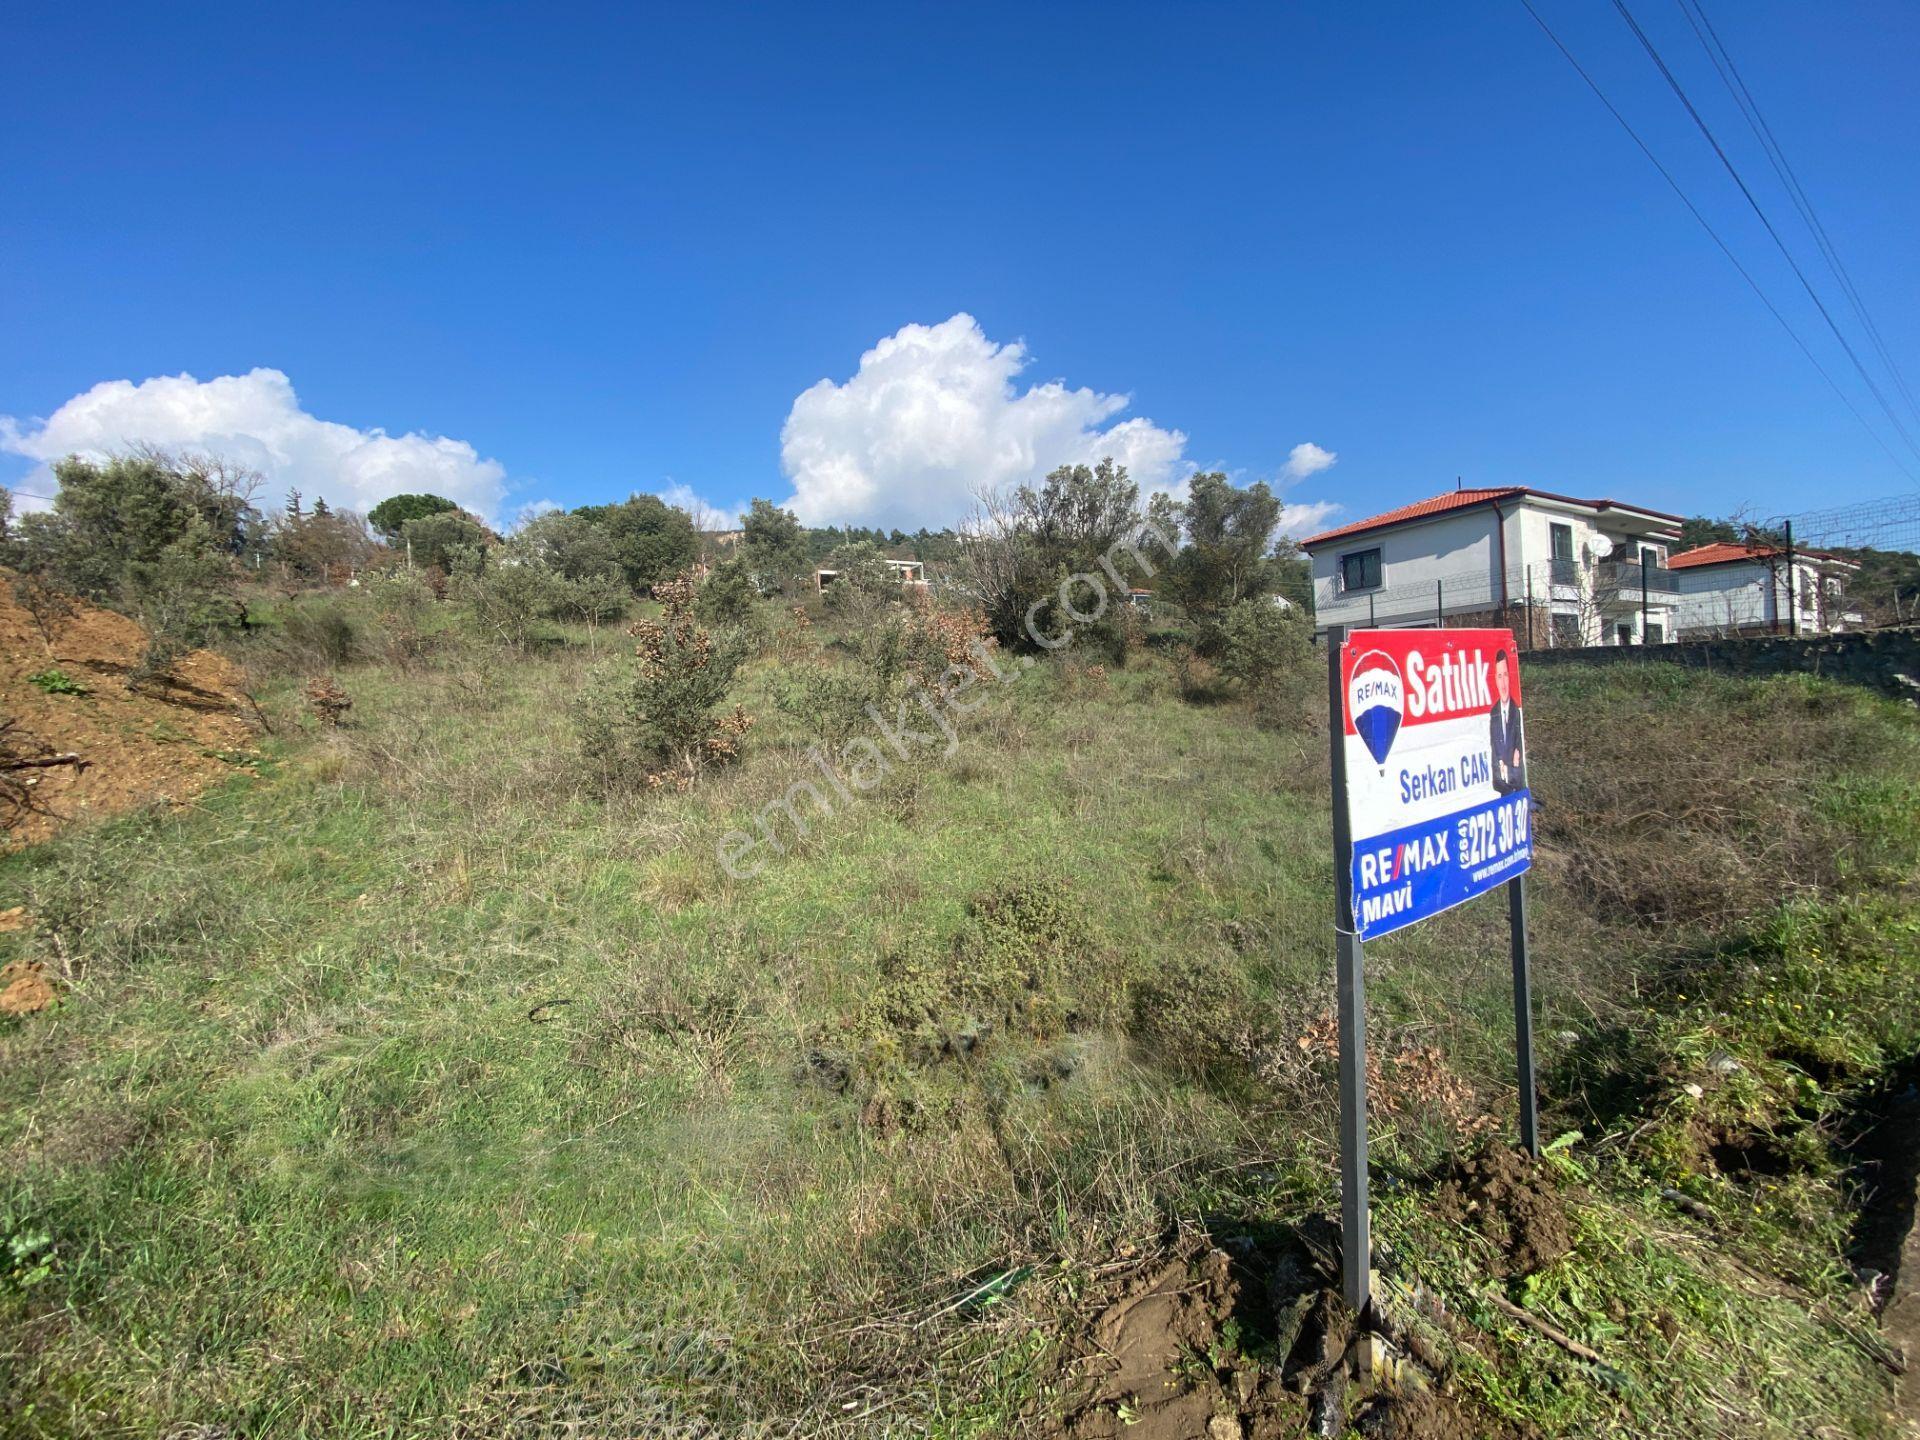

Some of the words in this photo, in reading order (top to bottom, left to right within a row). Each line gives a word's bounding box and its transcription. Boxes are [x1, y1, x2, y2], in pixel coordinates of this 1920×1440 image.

[1357, 682, 1398, 704] RE/MAX
[1406, 649, 1492, 718] Satılık
[1400, 764, 1456, 804] Serkan
[1461, 751, 1489, 788] CAN
[1361, 830, 1450, 890] RE/MAX
[1469, 810, 1497, 866] 272
[1498, 803, 1513, 853] 30
[1515, 797, 1528, 845] 30
